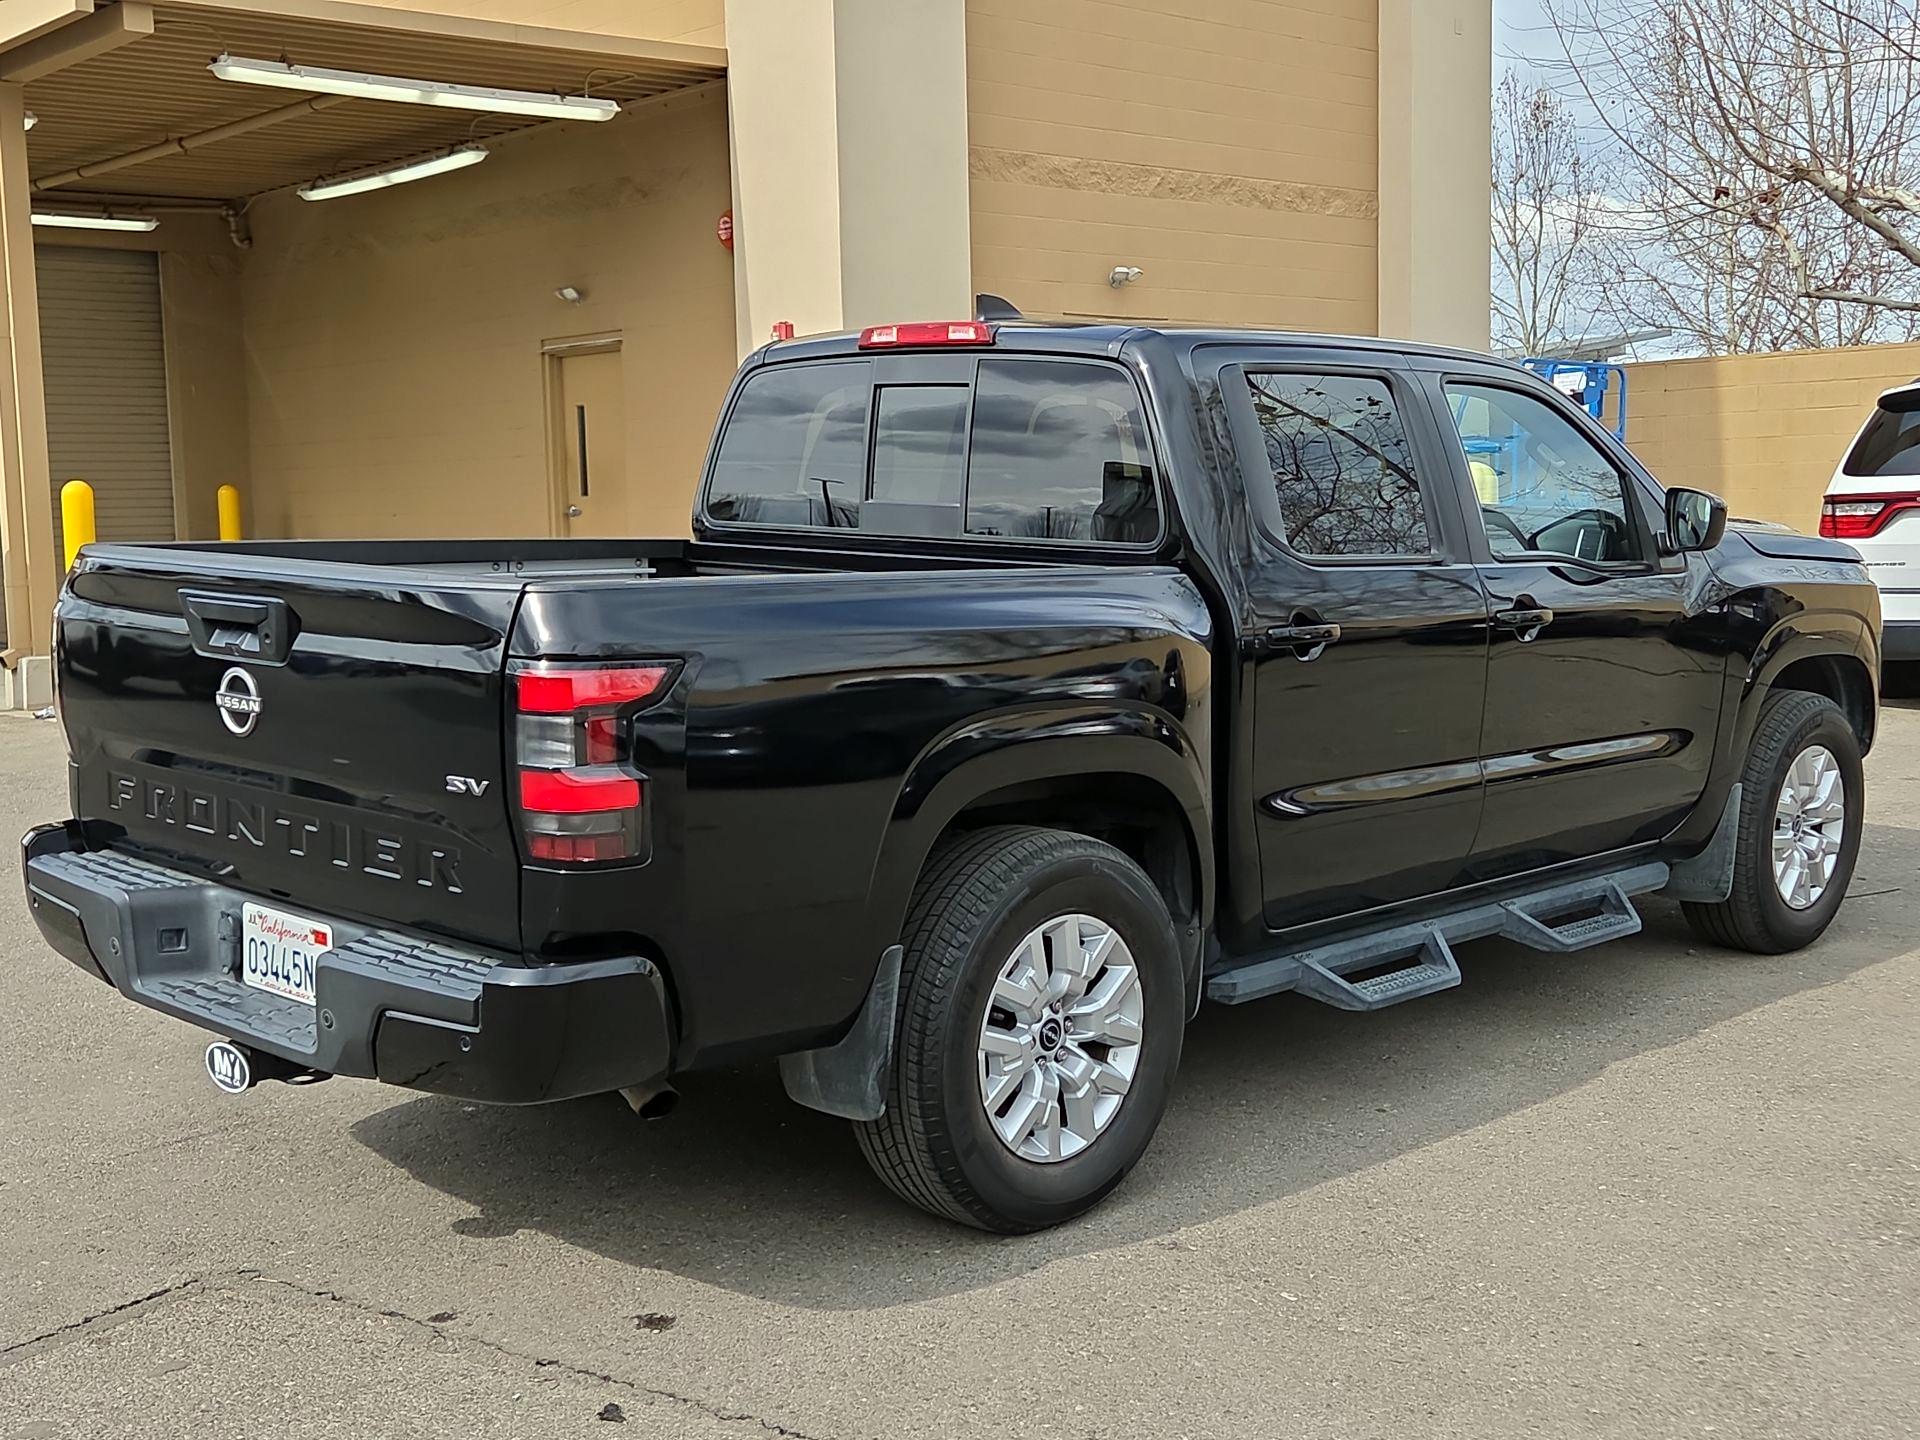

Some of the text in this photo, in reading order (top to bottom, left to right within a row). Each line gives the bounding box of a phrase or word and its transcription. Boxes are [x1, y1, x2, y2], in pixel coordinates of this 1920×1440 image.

[215, 693, 260, 713] NISSAN
[445, 774, 490, 797] SV
[106, 769, 464, 894] FRONTIER
[259, 914, 310, 943] California
[248, 936, 315, 994] 03445N
